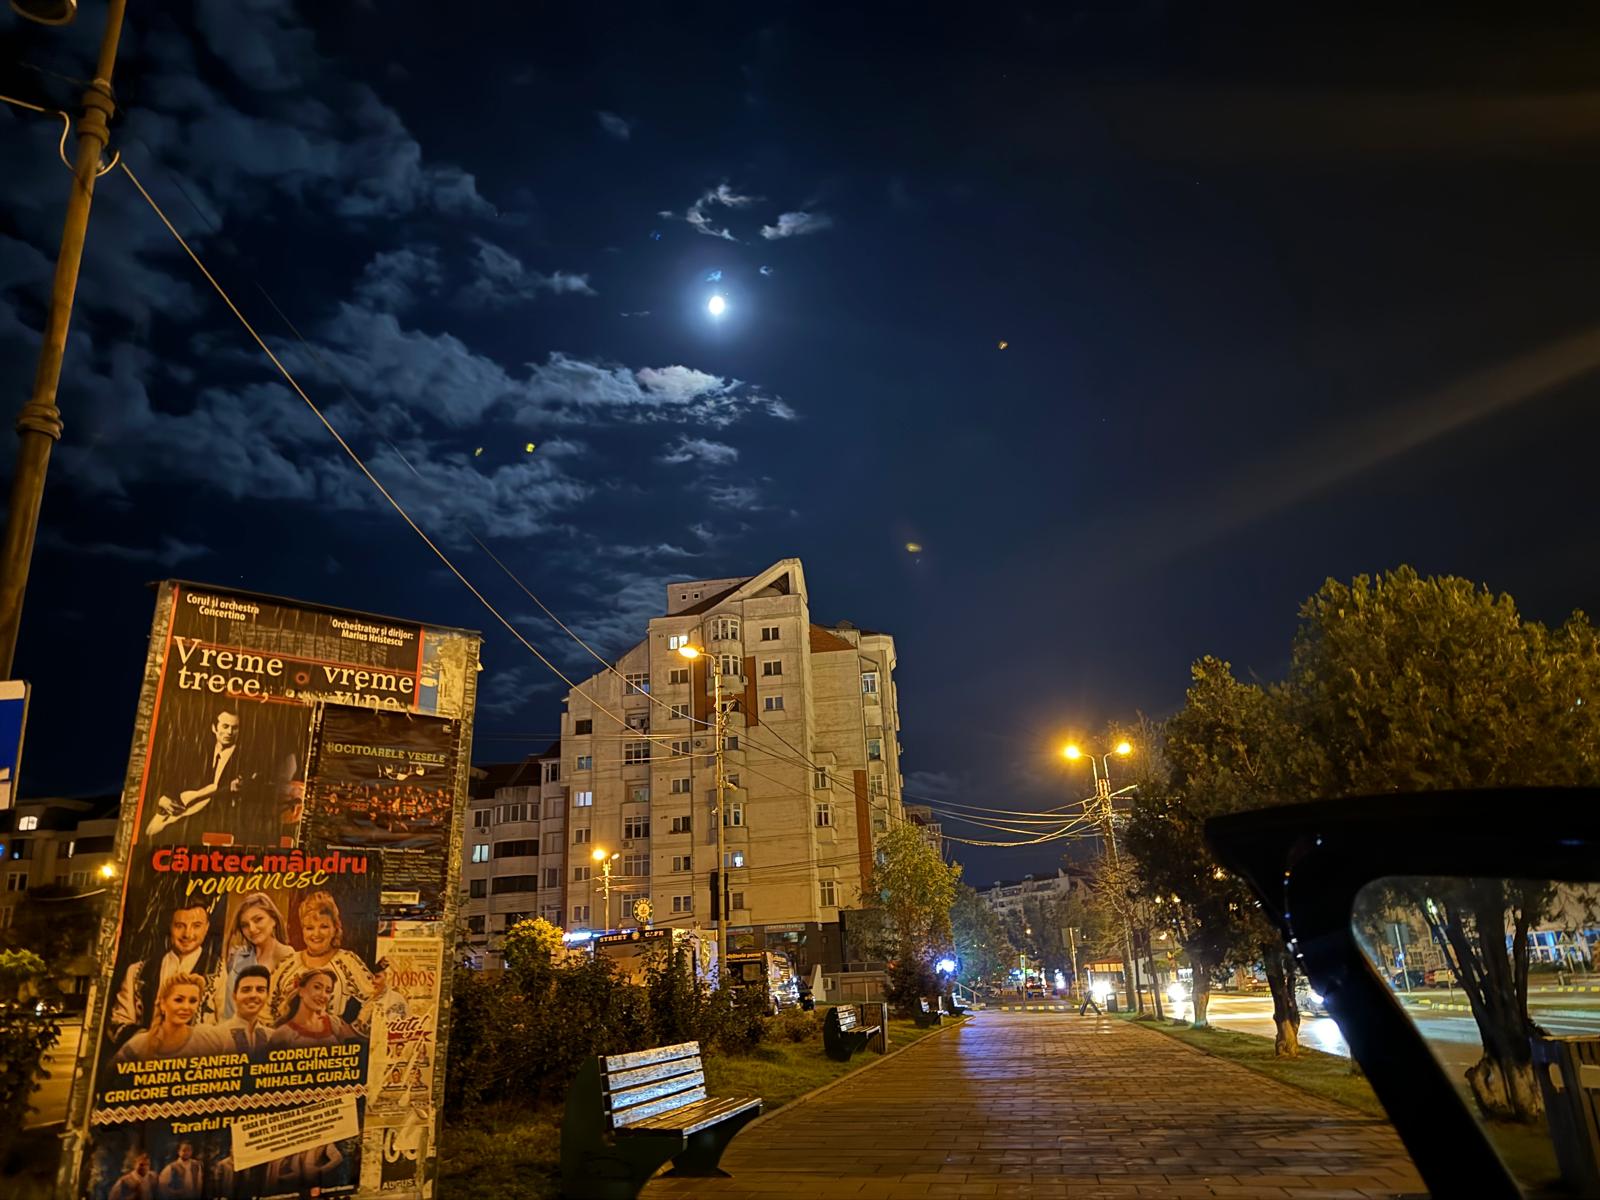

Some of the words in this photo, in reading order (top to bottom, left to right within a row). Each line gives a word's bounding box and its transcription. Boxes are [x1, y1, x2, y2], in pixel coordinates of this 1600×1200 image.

[186, 592, 210, 606] Corul
[219, 600, 260, 615] orchestra
[198, 605, 246, 621] Concertino
[331, 619, 380, 634] Orchestrator
[388, 627, 414, 640] dirijor:
[341, 629, 368, 641] Marius
[368, 634, 403, 646] Hristescu
[173, 635, 283, 676] Vreme
[323, 666, 413, 694] vreme
[178, 665, 269, 702] trece,
[407, 751, 446, 763] VESELE
[152, 847, 255, 873] Cântec
[262, 850, 368, 874] mândru
[185, 864, 329, 897] românesc
[599, 934, 627, 943] STREET
[330, 1044, 361, 1057] FILIP
[116, 1058, 187, 1074] VALENTIN
[189, 1053, 250, 1068] SANFIRA
[249, 1061, 294, 1076] EMILIA
[296, 1057, 359, 1072] GHINESCU
[133, 1071, 182, 1086] MARIA
[184, 1066, 244, 1081] CÂRNECI
[255, 1073, 314, 1089] MIHAELA
[316, 1067, 360, 1083] GURĂU
[104, 1086, 169, 1103] GRIGORE
[171, 1080, 241, 1097] GHERMAN
[170, 1117, 220, 1134] Taraful
[241, 1120, 259, 1131] CASA
[259, 1118, 268, 1127] DE
